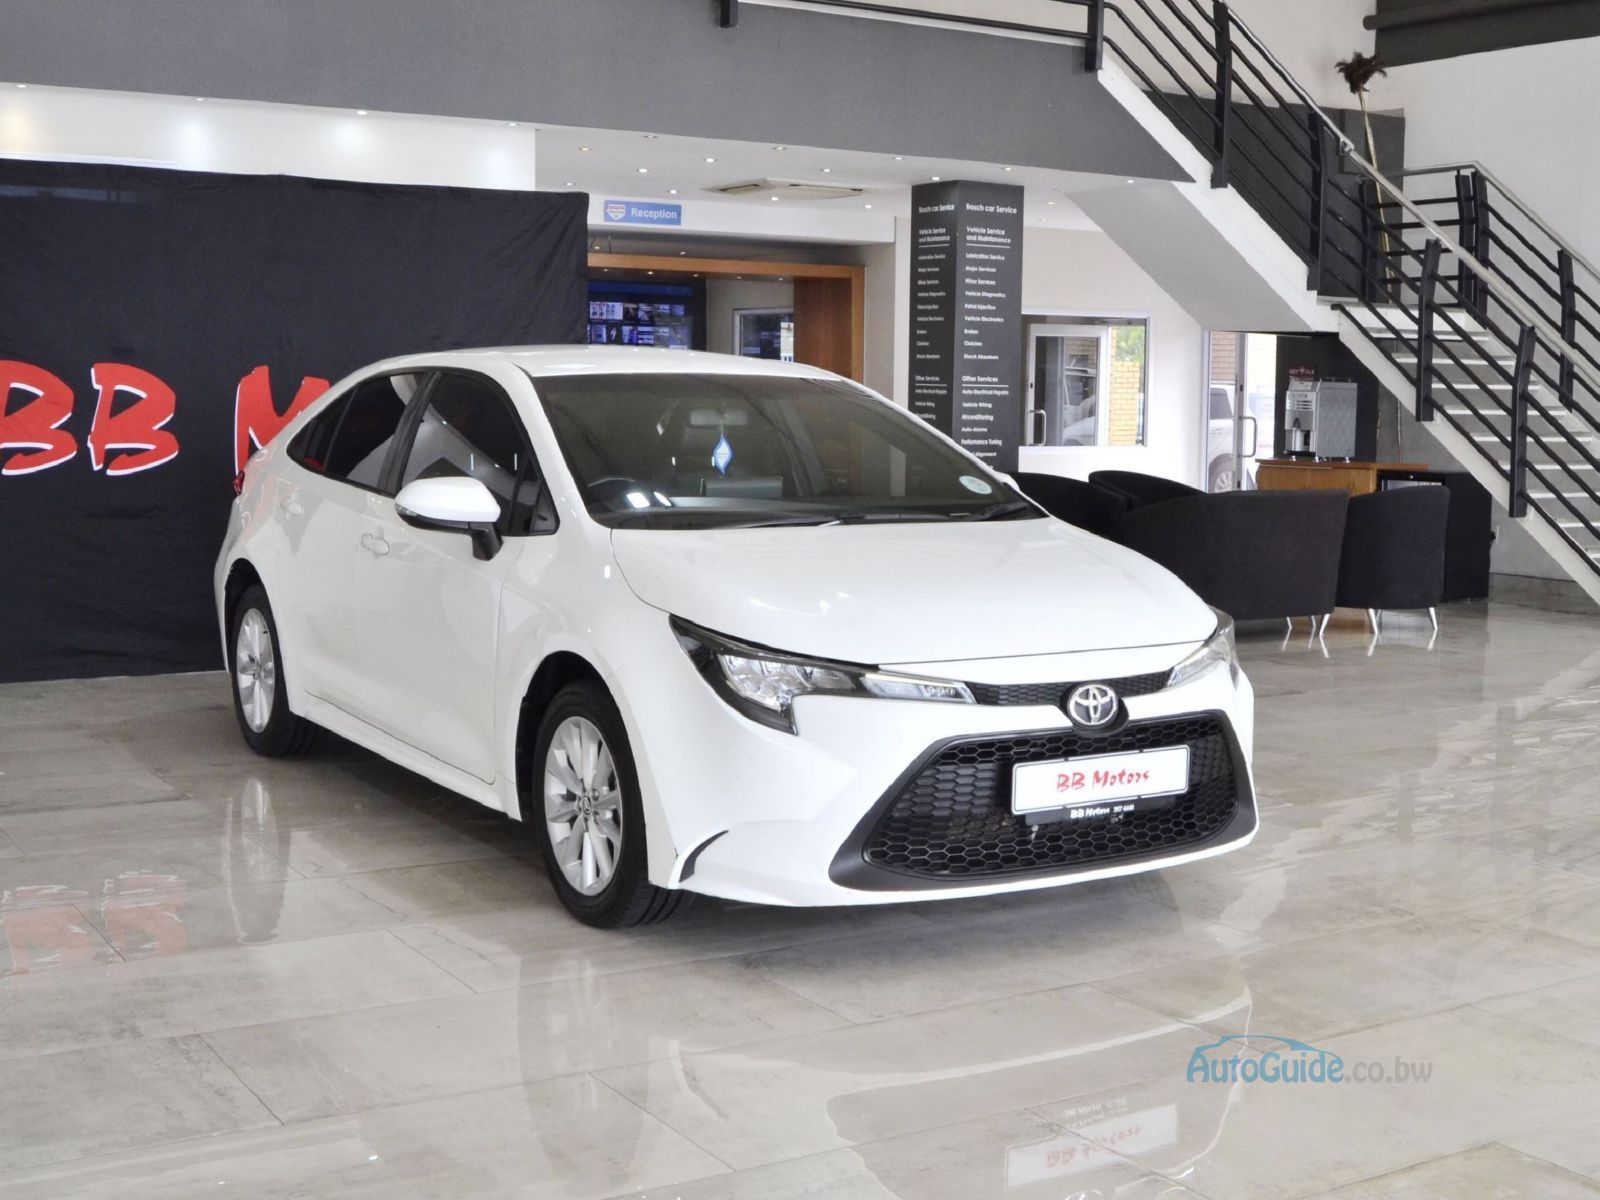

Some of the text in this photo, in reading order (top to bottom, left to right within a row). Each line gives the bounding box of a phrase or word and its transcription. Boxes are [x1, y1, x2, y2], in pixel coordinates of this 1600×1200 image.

[631, 208, 677, 219] Reception
[965, 203, 984, 212] Bosch
[996, 205, 1017, 214] Service
[966, 226, 986, 234] Vehicle
[0, 359, 180, 476] BB
[1057, 768, 1151, 792] BB Motors
[1070, 808, 1085, 819] BB
